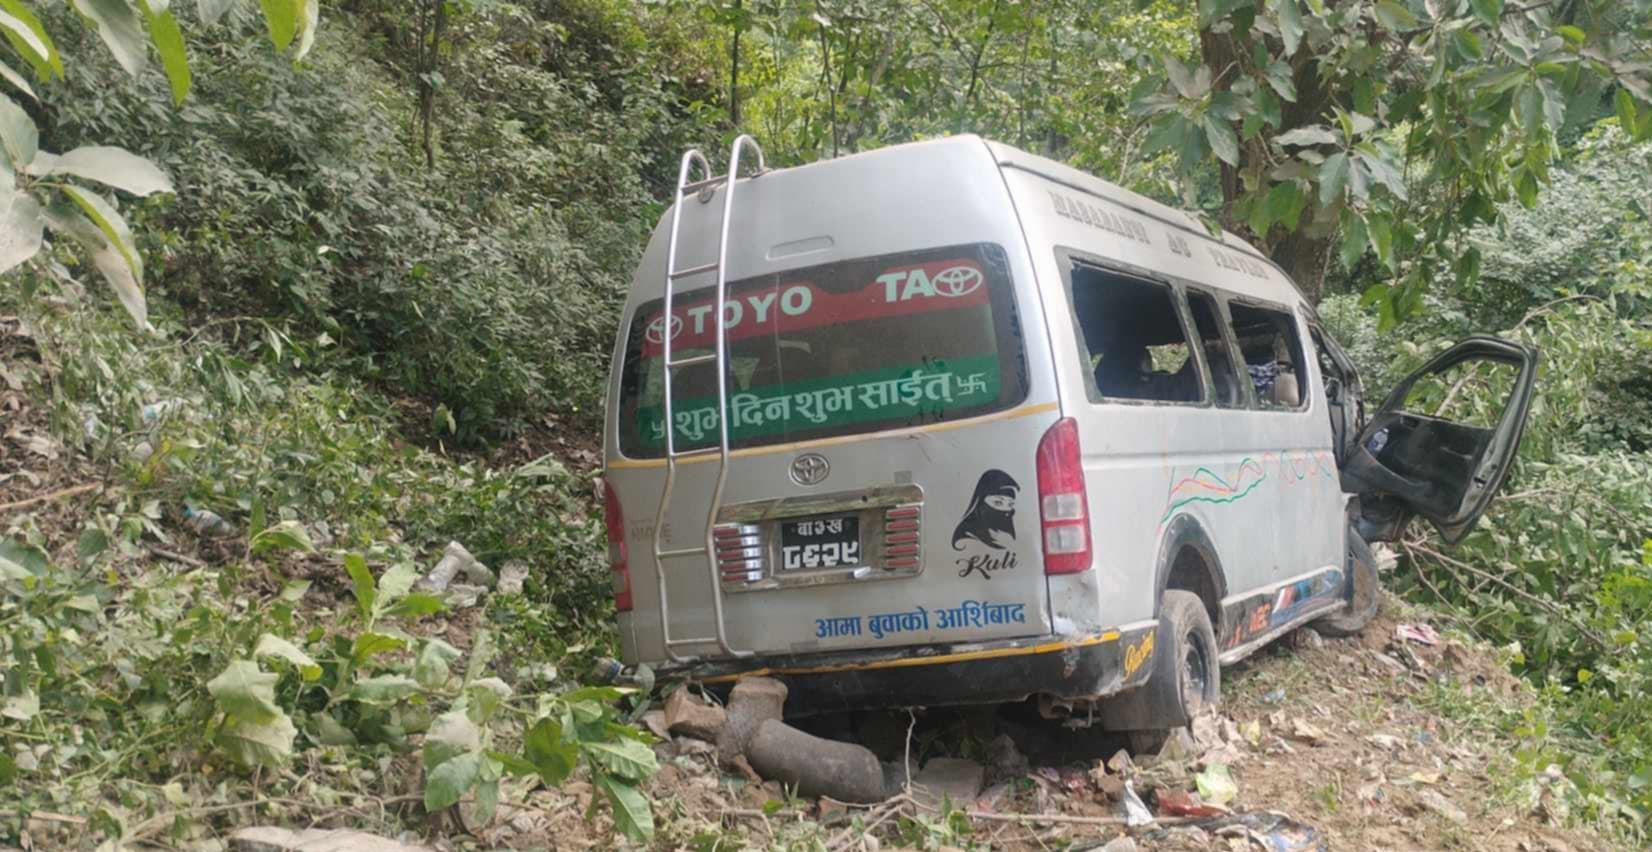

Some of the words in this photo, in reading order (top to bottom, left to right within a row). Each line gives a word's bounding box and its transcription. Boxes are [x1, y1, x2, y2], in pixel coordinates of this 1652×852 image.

[688, 286, 813, 335] TOYO
[876, 269, 936, 303] TA
[731, 393, 793, 428] दिन
[795, 385, 855, 423] शुभ
[816, 616, 862, 638] आमा
